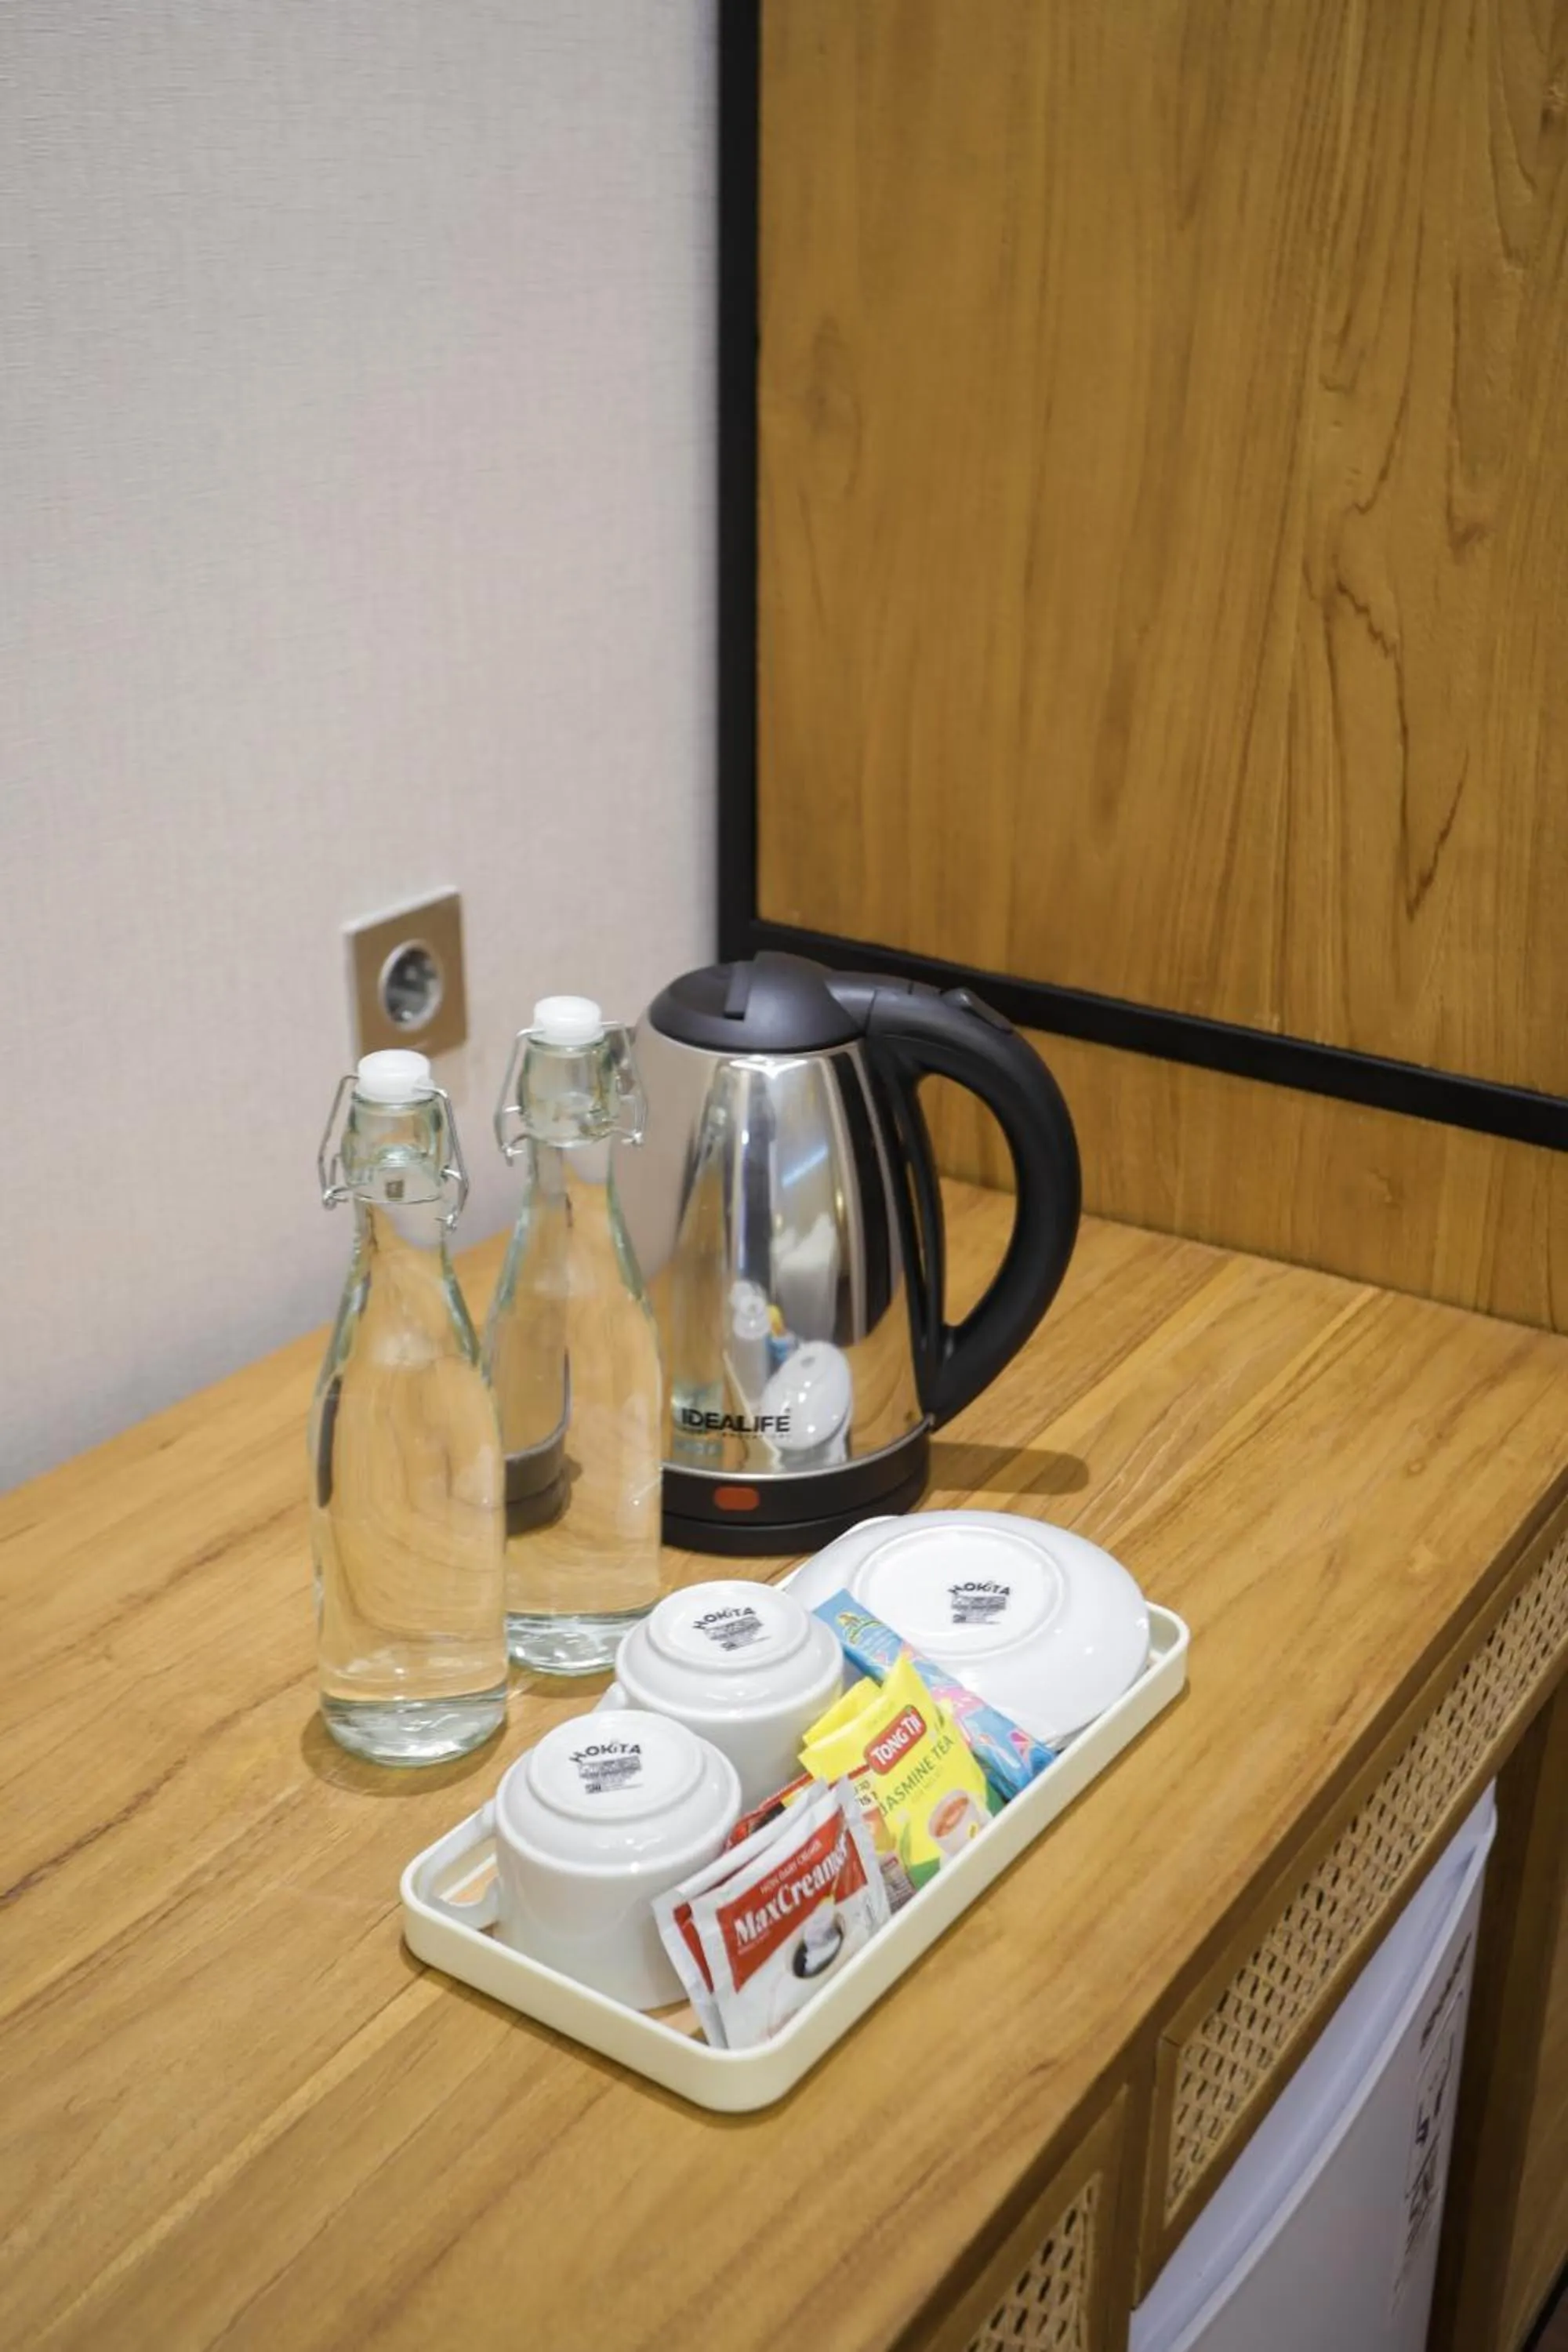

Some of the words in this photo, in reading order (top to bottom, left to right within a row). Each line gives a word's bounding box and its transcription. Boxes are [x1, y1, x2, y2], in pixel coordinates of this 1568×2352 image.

[681, 1408, 791, 1432] IDEALIFE
[869, 1728, 909, 1765] TONG
[880, 1755, 935, 1817] JASMINE
[931, 1735, 954, 1760] TEA
